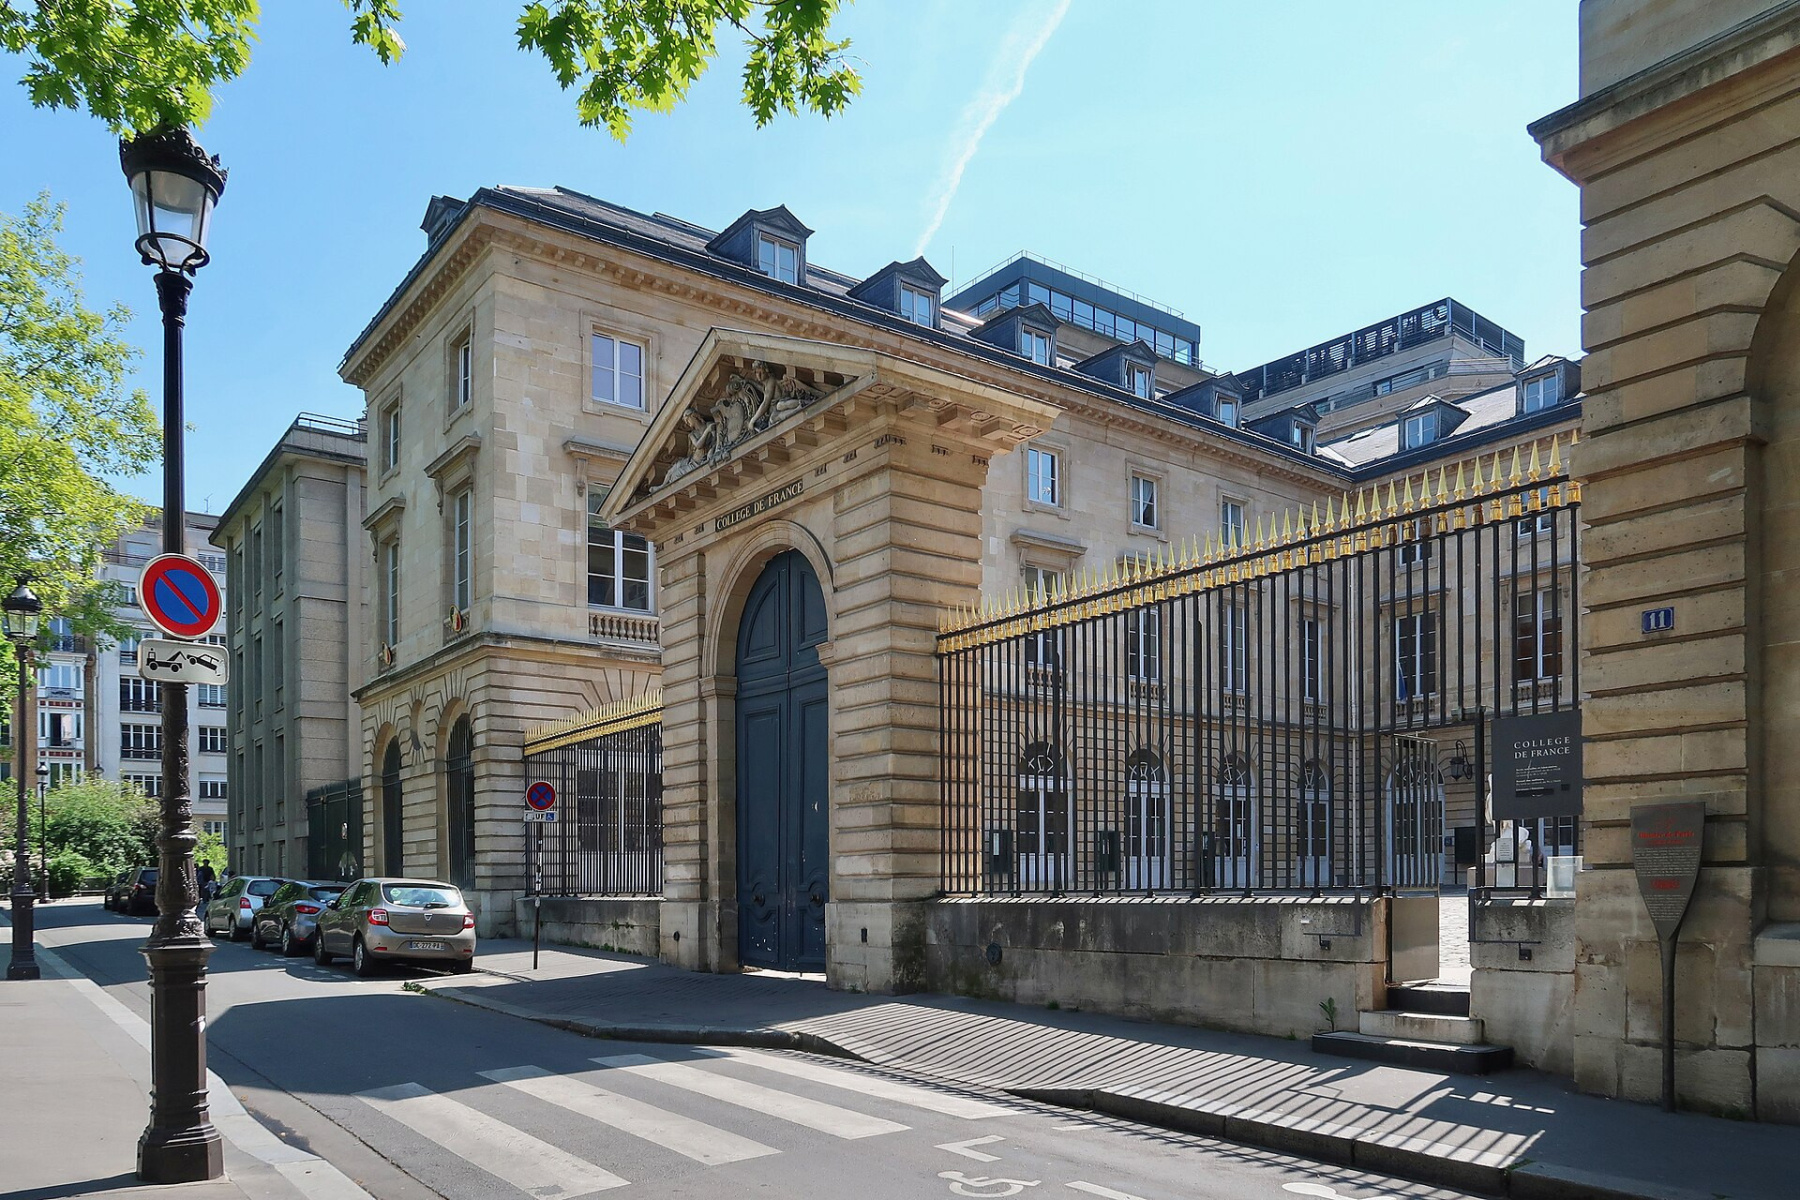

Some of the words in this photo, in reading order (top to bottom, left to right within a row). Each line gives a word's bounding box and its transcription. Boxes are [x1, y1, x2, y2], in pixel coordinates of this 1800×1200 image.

[716, 506, 751, 530] COLLEGE
[754, 499, 766, 514] DE
[768, 482, 803, 507] FRANCE
[1649, 610, 1666, 630] 11
[1514, 736, 1570, 750] COLLEGE
[1514, 751, 1528, 759] DE
[1531, 746, 1570, 758] FRANCE
